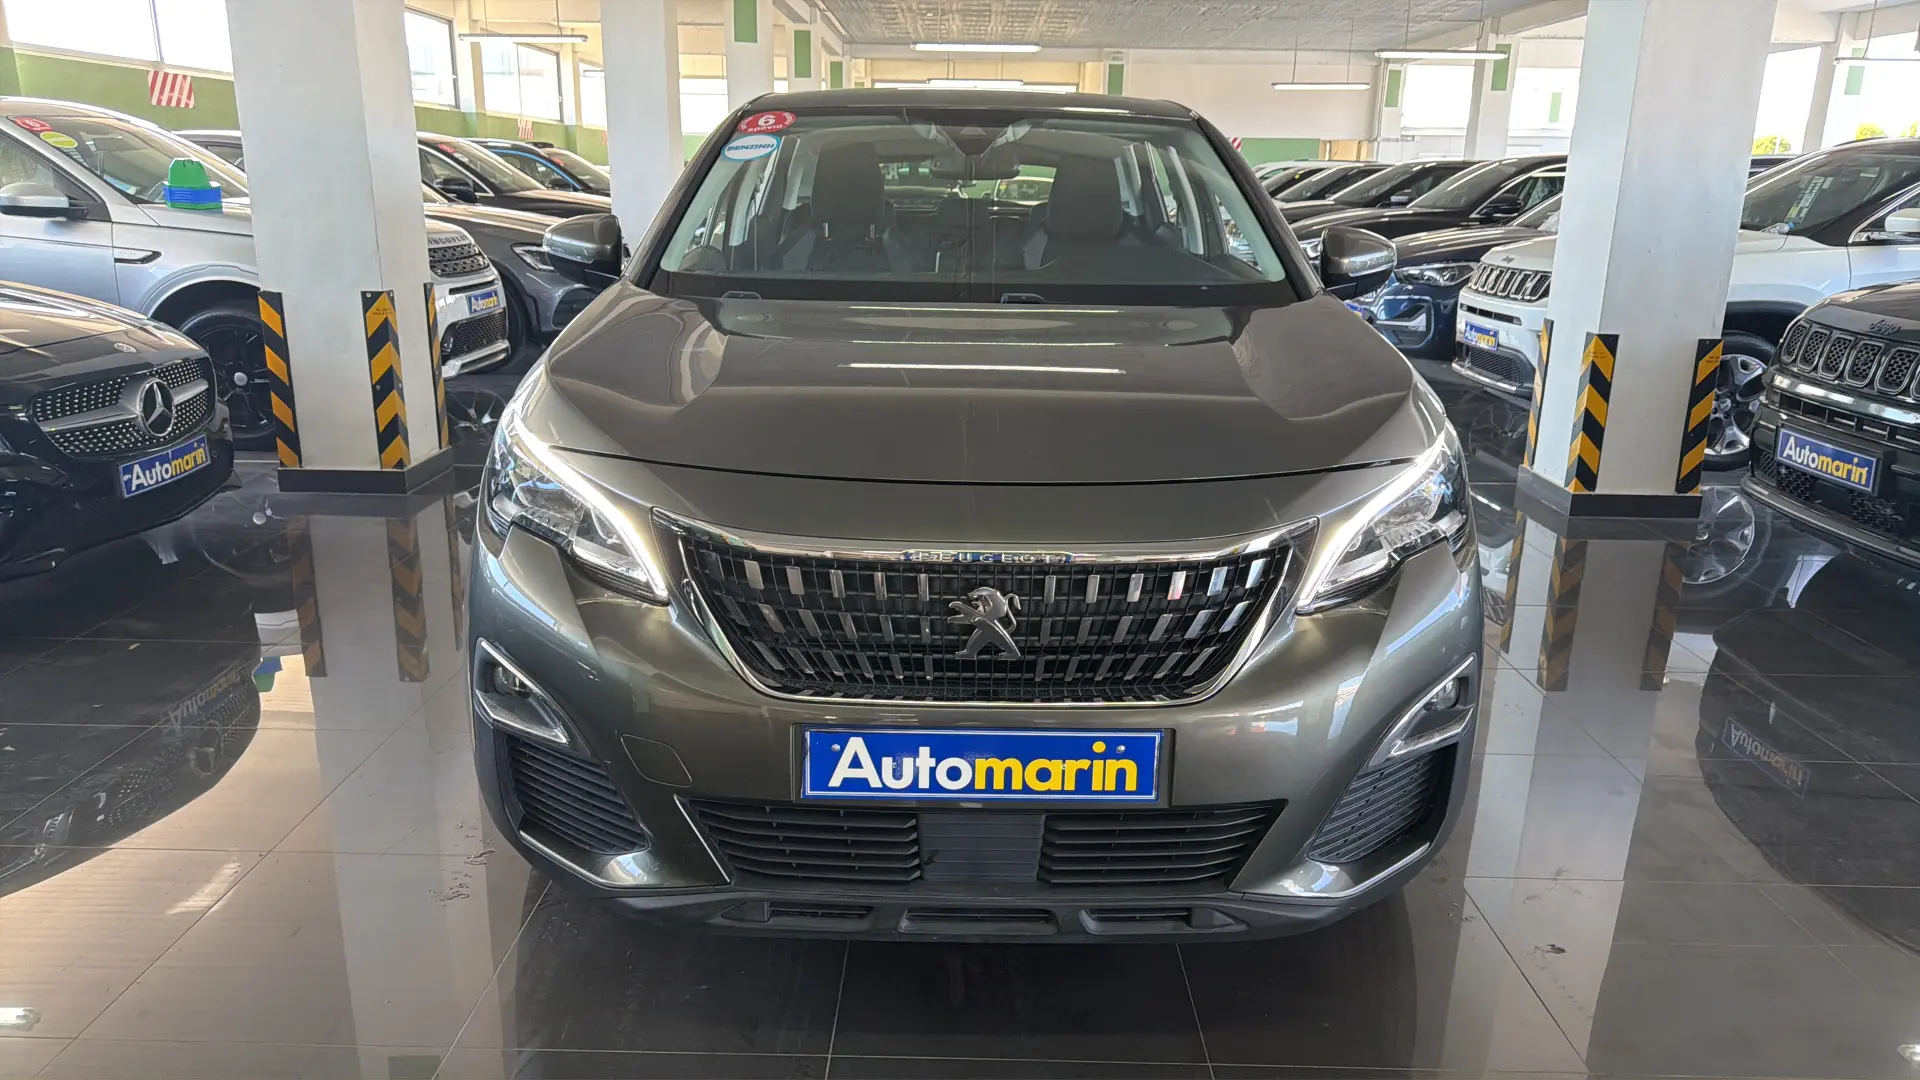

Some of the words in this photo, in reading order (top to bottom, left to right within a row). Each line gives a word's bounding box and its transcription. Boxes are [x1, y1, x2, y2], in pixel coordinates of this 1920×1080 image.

[758, 114, 776, 126] 6
[131, 441, 206, 491] Automarin
[1782, 435, 1868, 485] Automarin
[828, 736, 1138, 791] Automarin
